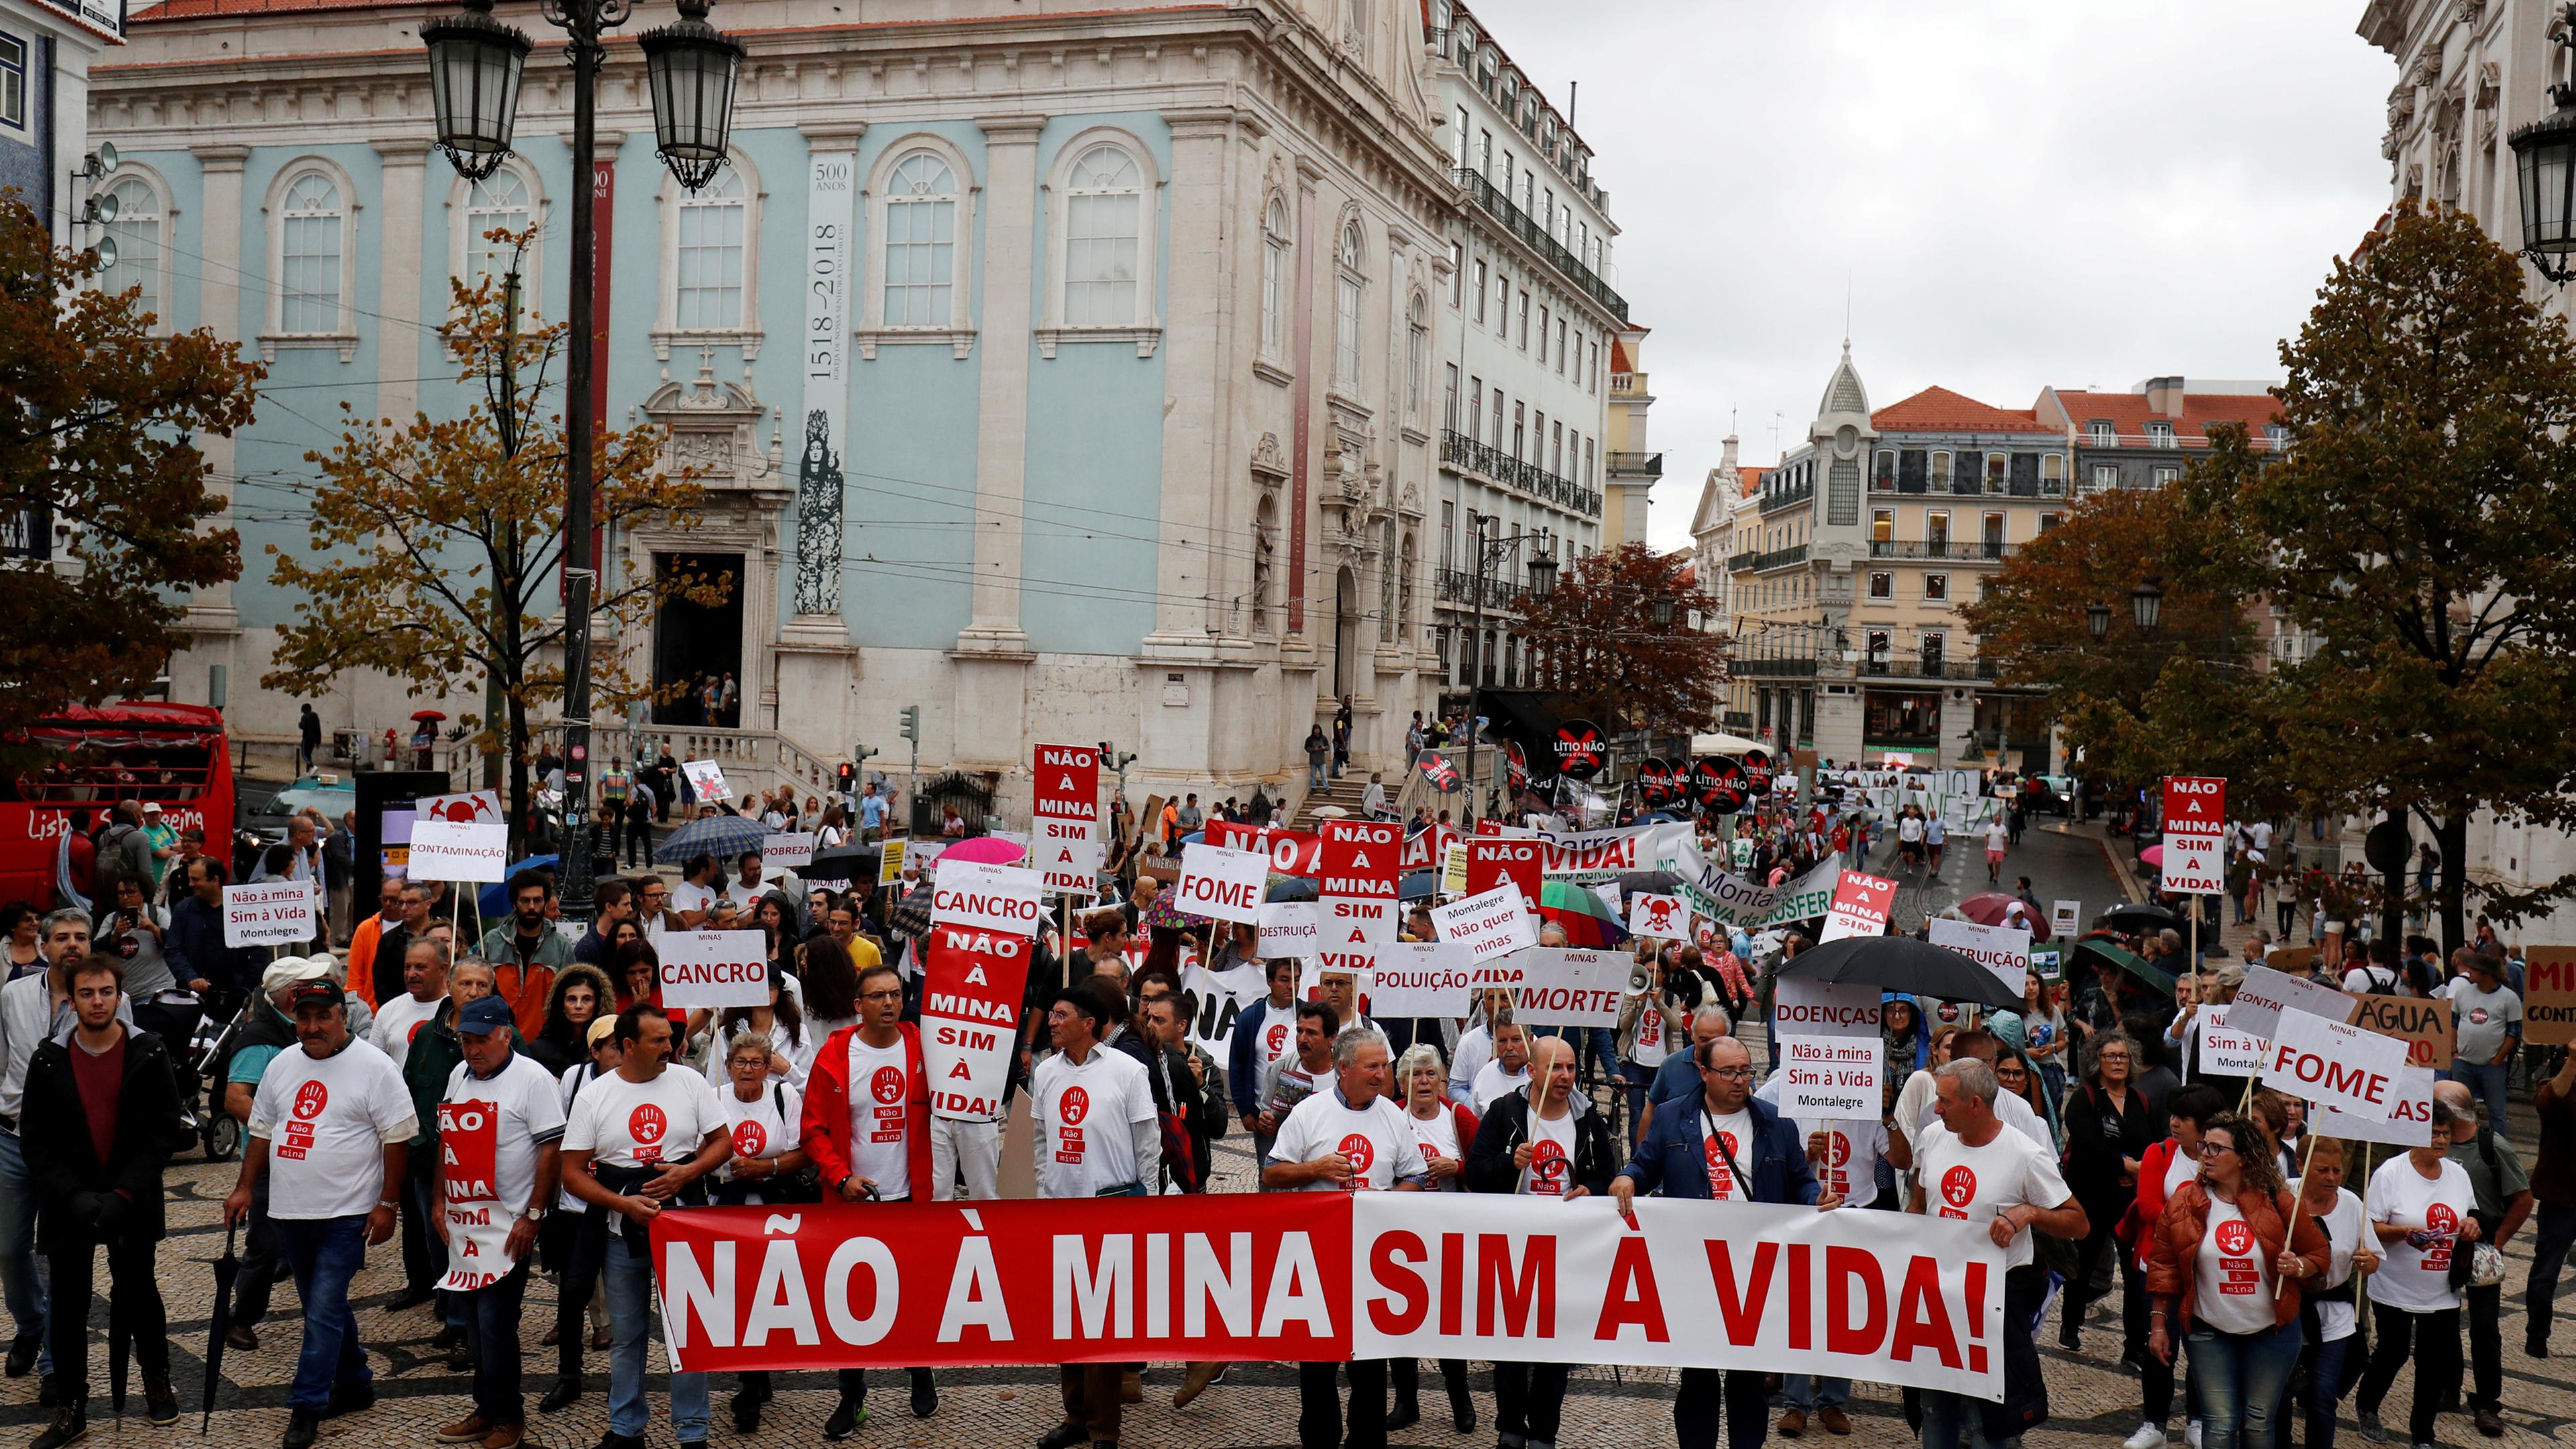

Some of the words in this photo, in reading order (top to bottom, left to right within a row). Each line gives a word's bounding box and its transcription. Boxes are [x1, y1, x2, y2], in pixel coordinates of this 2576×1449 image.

[816, 163, 847, 180] 500
[816, 182, 846, 191] ANOS
[837, 259, 843, 271] DO
[1554, 740, 1580, 751] LÍTIO
[1582, 740, 1605, 752] NÃO
[1044, 749, 1091, 767] NÃO
[1676, 773, 1690, 783] NÃO
[1760, 766, 1772, 775] NÃO
[1059, 773, 1075, 791] À
[1640, 773, 1657, 784] LÍTIO
[1658, 775, 1672, 786] NÃO
[1696, 773, 1723, 786] LÍTIO
[1725, 778, 1747, 790] NÃO
[2173, 780, 2217, 794] NÃO
[1039, 798, 1095, 817] MINA
[2187, 799, 2202, 812] À
[1047, 824, 1086, 840] SIM
[1334, 825, 1392, 843] NÃO
[2168, 820, 2222, 833] MINA
[411, 843, 505, 859] CONTAMINAÇÃO
[763, 846, 811, 855] POBREZA
[1477, 844, 1533, 861] NÃO
[2176, 839, 2212, 851] SIM
[1057, 846, 1073, 863] À
[1216, 850, 1235, 858] MINAS
[1351, 850, 1371, 868] À
[1544, 837, 1635, 870] VIDA!
[979, 866, 1002, 875] MINAS
[2186, 857, 2200, 870] À
[1495, 868, 1512, 885] À
[1847, 874, 1888, 891] NÃO
[2166, 876, 2220, 890] VIDA!
[1182, 875, 1257, 908] FOME
[1325, 877, 1395, 894] MINA
[232, 891, 257, 903] Não
[261, 890, 268, 901] à
[272, 889, 304, 900] mina
[1856, 890, 1870, 902] À
[934, 890, 1037, 921] CANCRO
[1334, 903, 1383, 919] SIM
[1448, 894, 1505, 919] Montalegre
[1835, 902, 1884, 922] MINA
[231, 910, 257, 923] Sim
[262, 908, 270, 920] à
[274, 906, 307, 920] Vida
[240, 927, 299, 938] Montalegre
[1260, 922, 1318, 938] DESTRUIÇÃ
[1450, 923, 1479, 940] Não
[1483, 909, 1515, 930] quer
[1838, 918, 1872, 933] SIM
[1348, 926, 1366, 943] À
[947, 930, 1018, 958] NÃO
[1564, 954, 1598, 963] MINAS
[661, 962, 765, 984] CANCRO
[964, 962, 987, 986] À
[1375, 969, 1468, 991] POLUIÇÃO
[2290, 979, 2314, 991] MINAS
[1520, 987, 1619, 1012] MORTE
[930, 993, 1014, 1023] MINA
[1184, 987, 1241, 1040] NÃ
[1778, 1005, 1878, 1027] DOENÇAS
[2355, 998, 2443, 1034] ÁGUA
[936, 1026, 996, 1051] SIM
[2329, 1024, 2357, 1037] MINAS
[2208, 1036, 2237, 1050] Sim
[2243, 1037, 2251, 1051] à
[1792, 1044, 1821, 1058] Não
[1825, 1044, 1833, 1059] à
[1838, 1046, 1872, 1060] mina
[949, 1057, 971, 1081] À
[2274, 1044, 2390, 1105] FOME
[1789, 1069, 1818, 1085] Sim
[1824, 1070, 1832, 1085] à
[1839, 1071, 1872, 1087] Vida
[1799, 1095, 1863, 1110] Montalegre
[290, 1124, 308, 1132] Não
[440, 1110, 483, 1132] ÃO
[1063, 1130, 1078, 1138] Não
[282, 1149, 303, 1158] mina
[1060, 1155, 1080, 1163] mina
[445, 1179, 493, 1197] INA
[1346, 1180, 1364, 1188] Não
[1537, 1182, 1556, 1191] Não
[463, 1236, 479, 1257] À
[2226, 1260, 2248, 1270] Não
[2427, 1263, 2449, 1271] mina
[665, 1213, 899, 1348] NÃO
[937, 1209, 1014, 1342] À
[1053, 1230, 1335, 1339] MINA
[1366, 1230, 1556, 1339] SIM
[1593, 1209, 1670, 1343] À
[1703, 1238, 1989, 1375] VIDA!
[2226, 1284, 2253, 1293] mina
